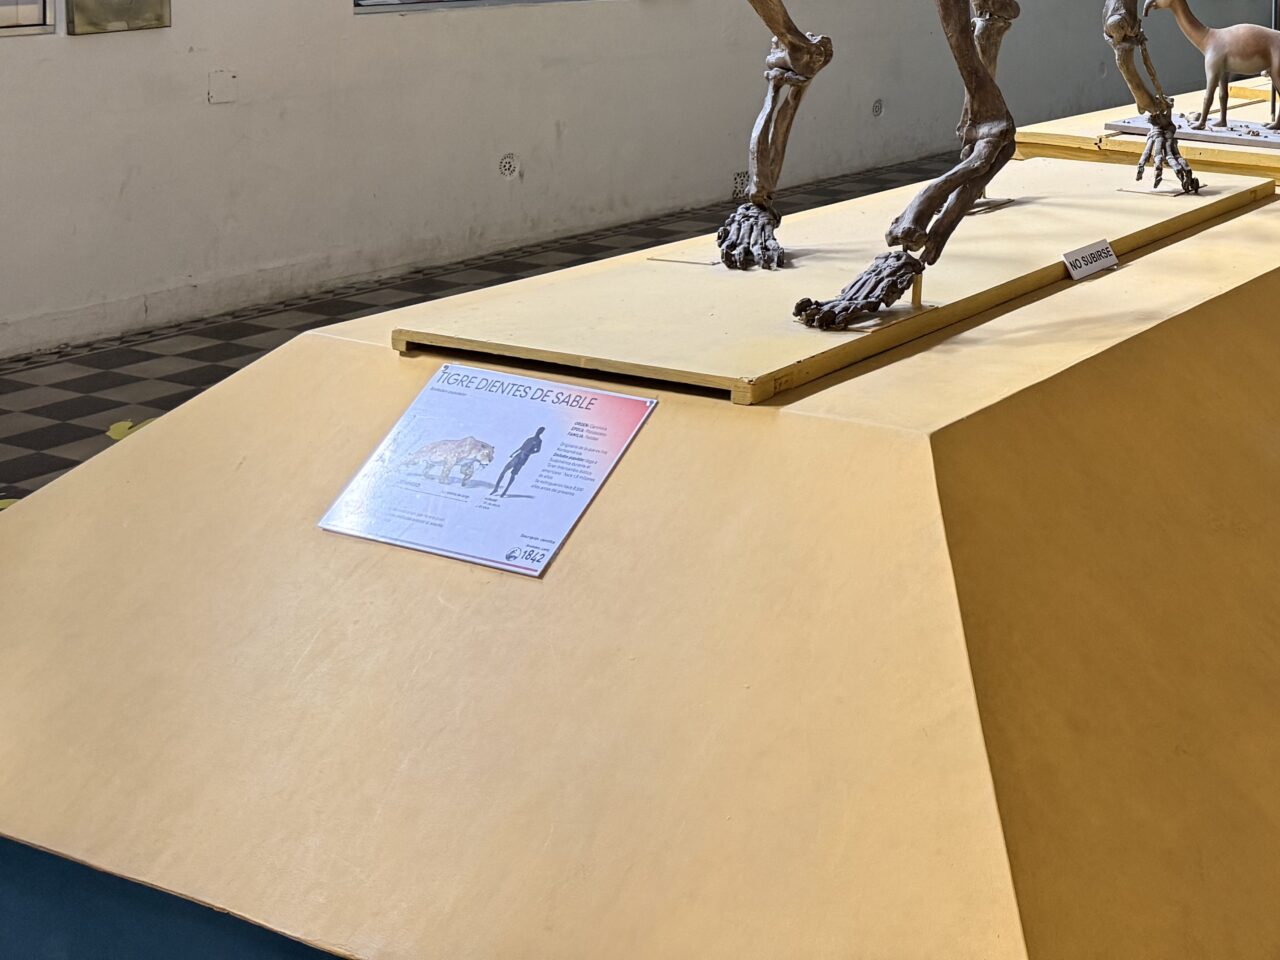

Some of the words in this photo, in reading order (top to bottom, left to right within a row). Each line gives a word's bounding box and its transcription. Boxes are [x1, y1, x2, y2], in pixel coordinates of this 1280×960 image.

[1069, 258, 1082, 271] NO
[1081, 246, 1113, 267] SUBIRSE
[436, 371, 477, 389] TIGRE
[475, 378, 532, 398] DIENTES
[530, 388, 553, 402] DE
[551, 392, 598, 410] SABLE
[521, 549, 546, 563] 1842
